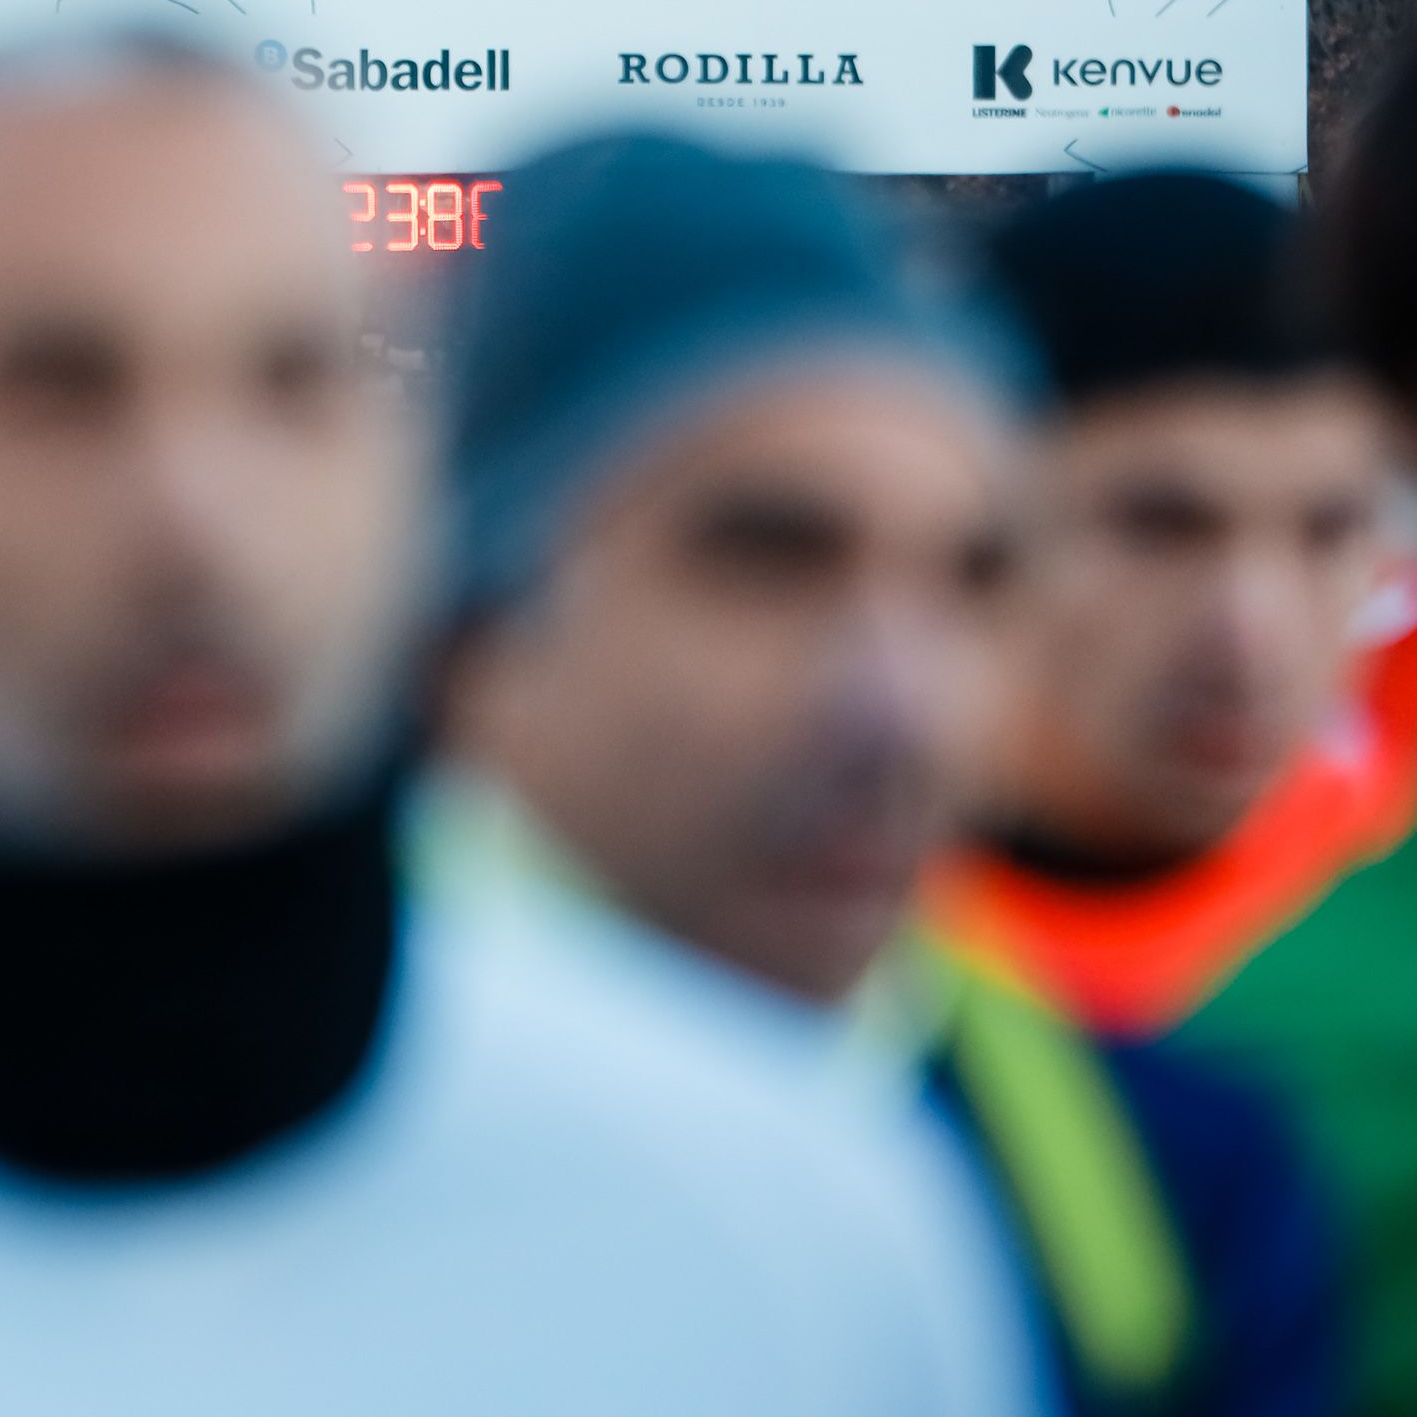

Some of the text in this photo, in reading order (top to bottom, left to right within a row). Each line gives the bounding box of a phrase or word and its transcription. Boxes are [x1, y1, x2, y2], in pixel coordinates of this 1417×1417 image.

[291, 47, 510, 91] Sabadell
[618, 53, 864, 84] RODILLA
[696, 96, 745, 107] DESDE
[972, 107, 1026, 118] LISTERINE
